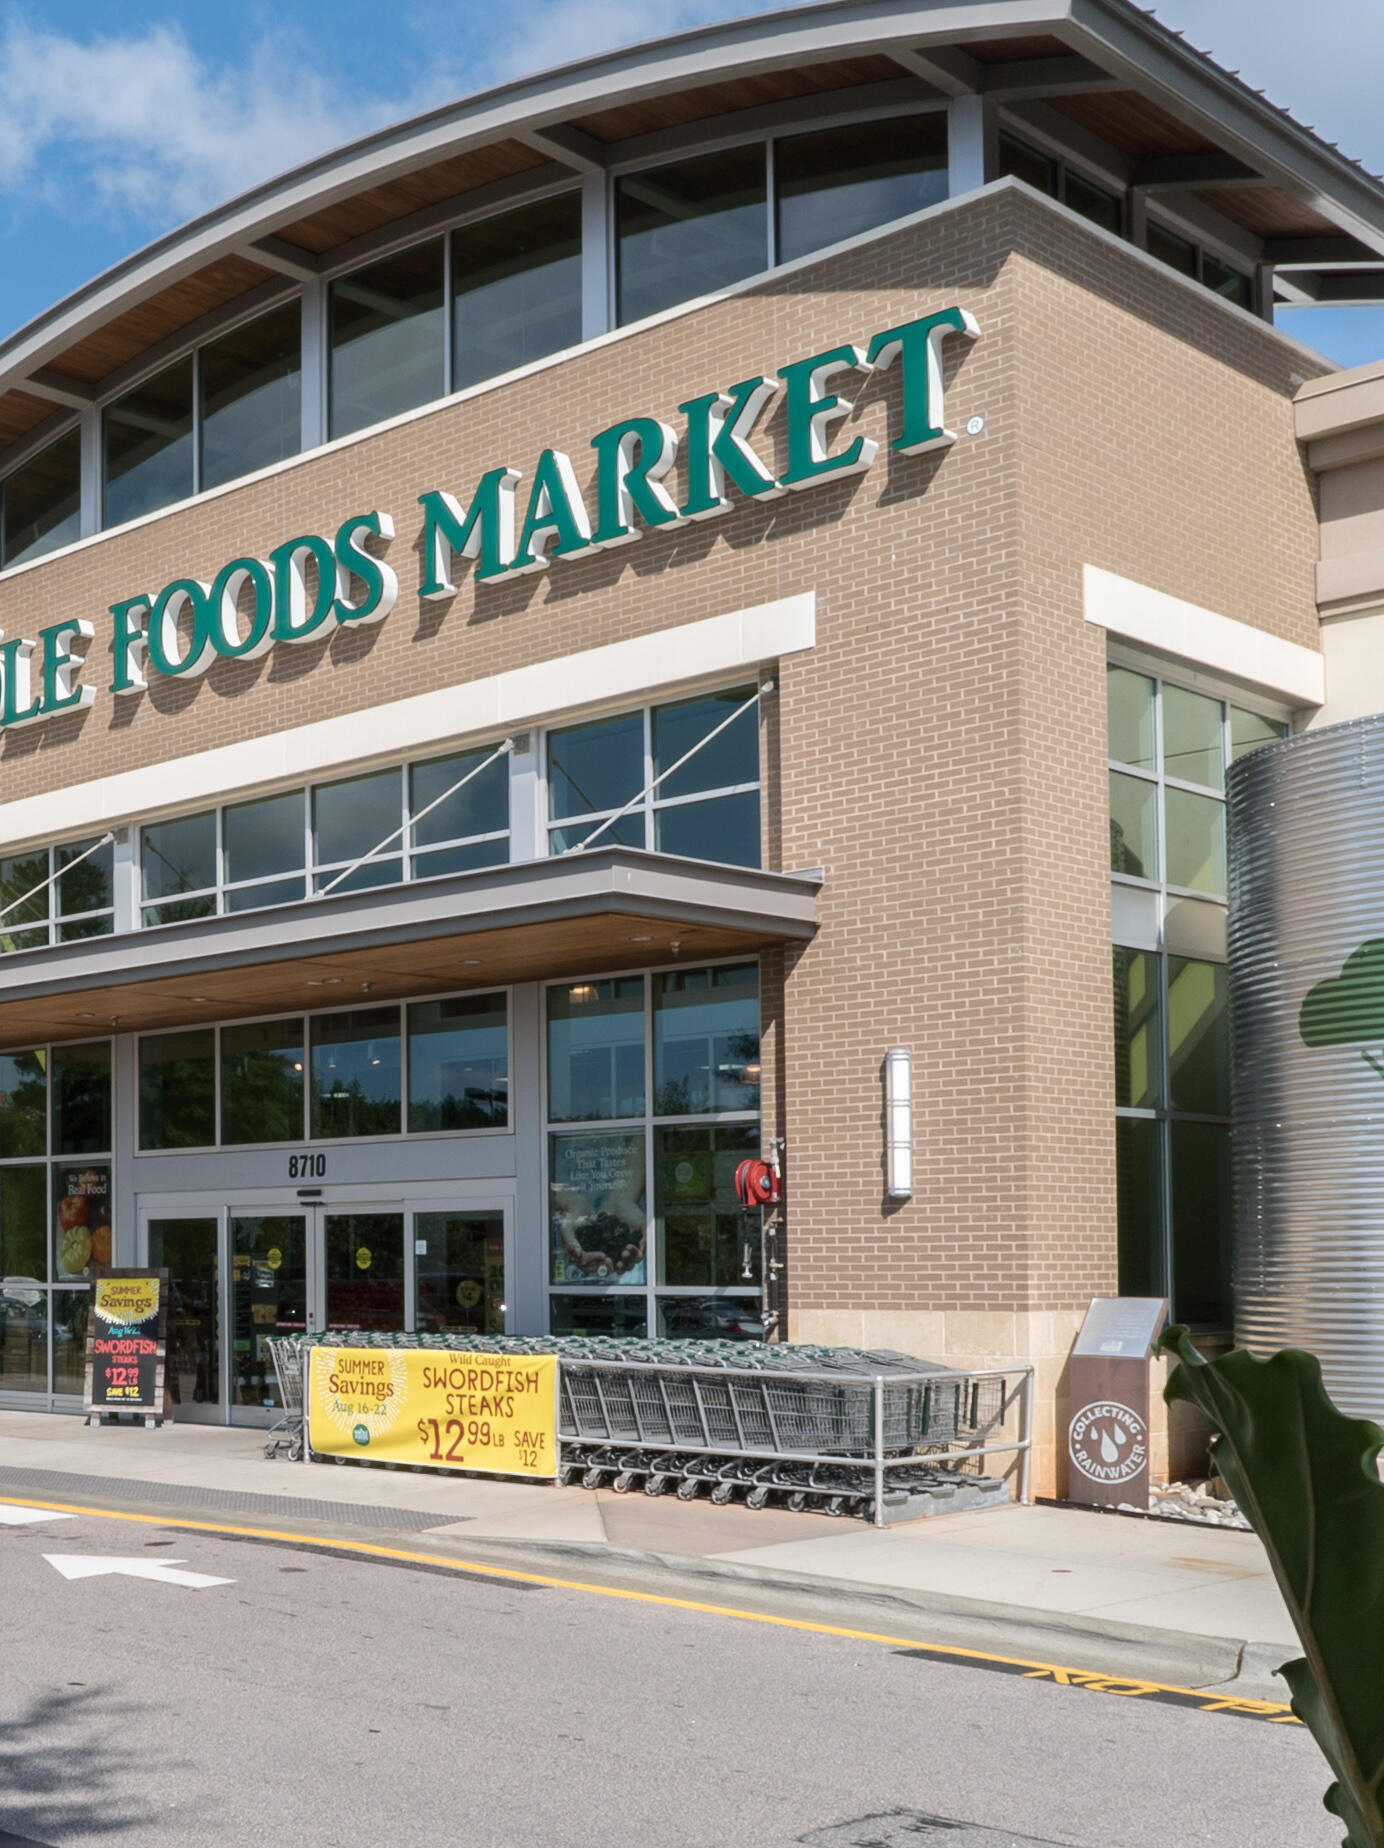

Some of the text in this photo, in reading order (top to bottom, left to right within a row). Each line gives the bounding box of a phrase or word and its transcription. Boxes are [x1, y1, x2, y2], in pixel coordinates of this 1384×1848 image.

[109, 511, 398, 694] FOODS
[419, 307, 980, 600] MARKET
[288, 1153, 326, 1179] 8710
[577, 1158, 596, 1169] That
[591, 1168, 608, 1179] You
[68, 1183, 107, 1195] Real Food
[111, 1286, 142, 1296] SUMMER
[100, 1294, 152, 1313] Savings
[94, 1339, 157, 1355] SWORDFISH
[338, 1358, 385, 1377] SUMMER
[449, 1352, 511, 1368] Wild Caught
[329, 1374, 394, 1402] Savings
[423, 1367, 540, 1394] SWORDFISH
[332, 1399, 387, 1416] Aug 16-22
[445, 1393, 515, 1418] STEAKS
[1073, 1407, 1139, 1440] COLLECTING
[493, 1432, 505, 1448] LB
[514, 1430, 546, 1450] SAVE
[518, 1449, 538, 1468] $12
[1076, 1444, 1145, 1478] RAINWATER
